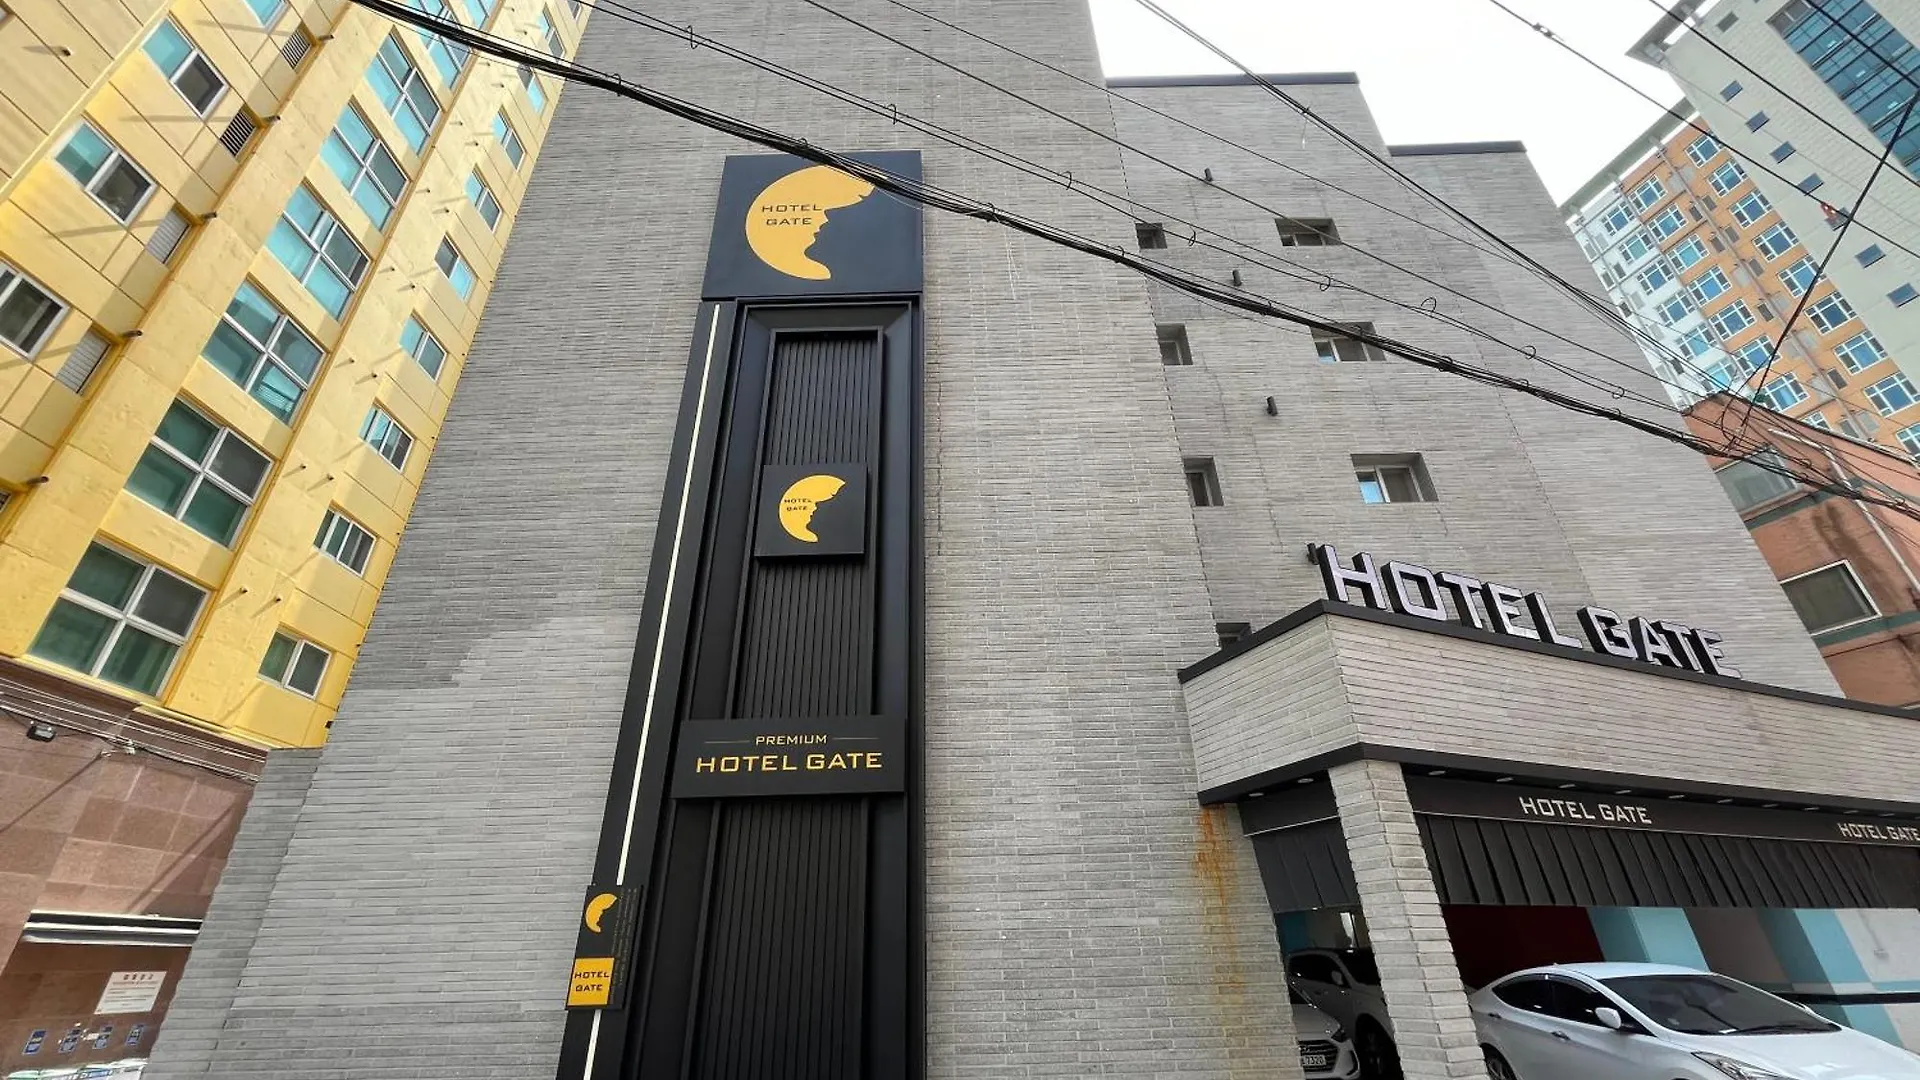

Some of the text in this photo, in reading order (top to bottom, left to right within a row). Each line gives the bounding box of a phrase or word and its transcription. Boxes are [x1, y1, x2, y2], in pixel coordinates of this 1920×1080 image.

[762, 204, 822, 213] HOTEL
[766, 217, 812, 226] GATE
[1320, 543, 1741, 679] HOTEL GATE
[755, 734, 829, 746] PREMIUM
[695, 752, 883, 773] HOTEL GATE
[1519, 796, 1653, 825] HOTEL GATE
[1837, 823, 1920, 841] HOTEL GATE
[574, 971, 610, 979] HOTEL
[575, 984, 603, 992] GATE
